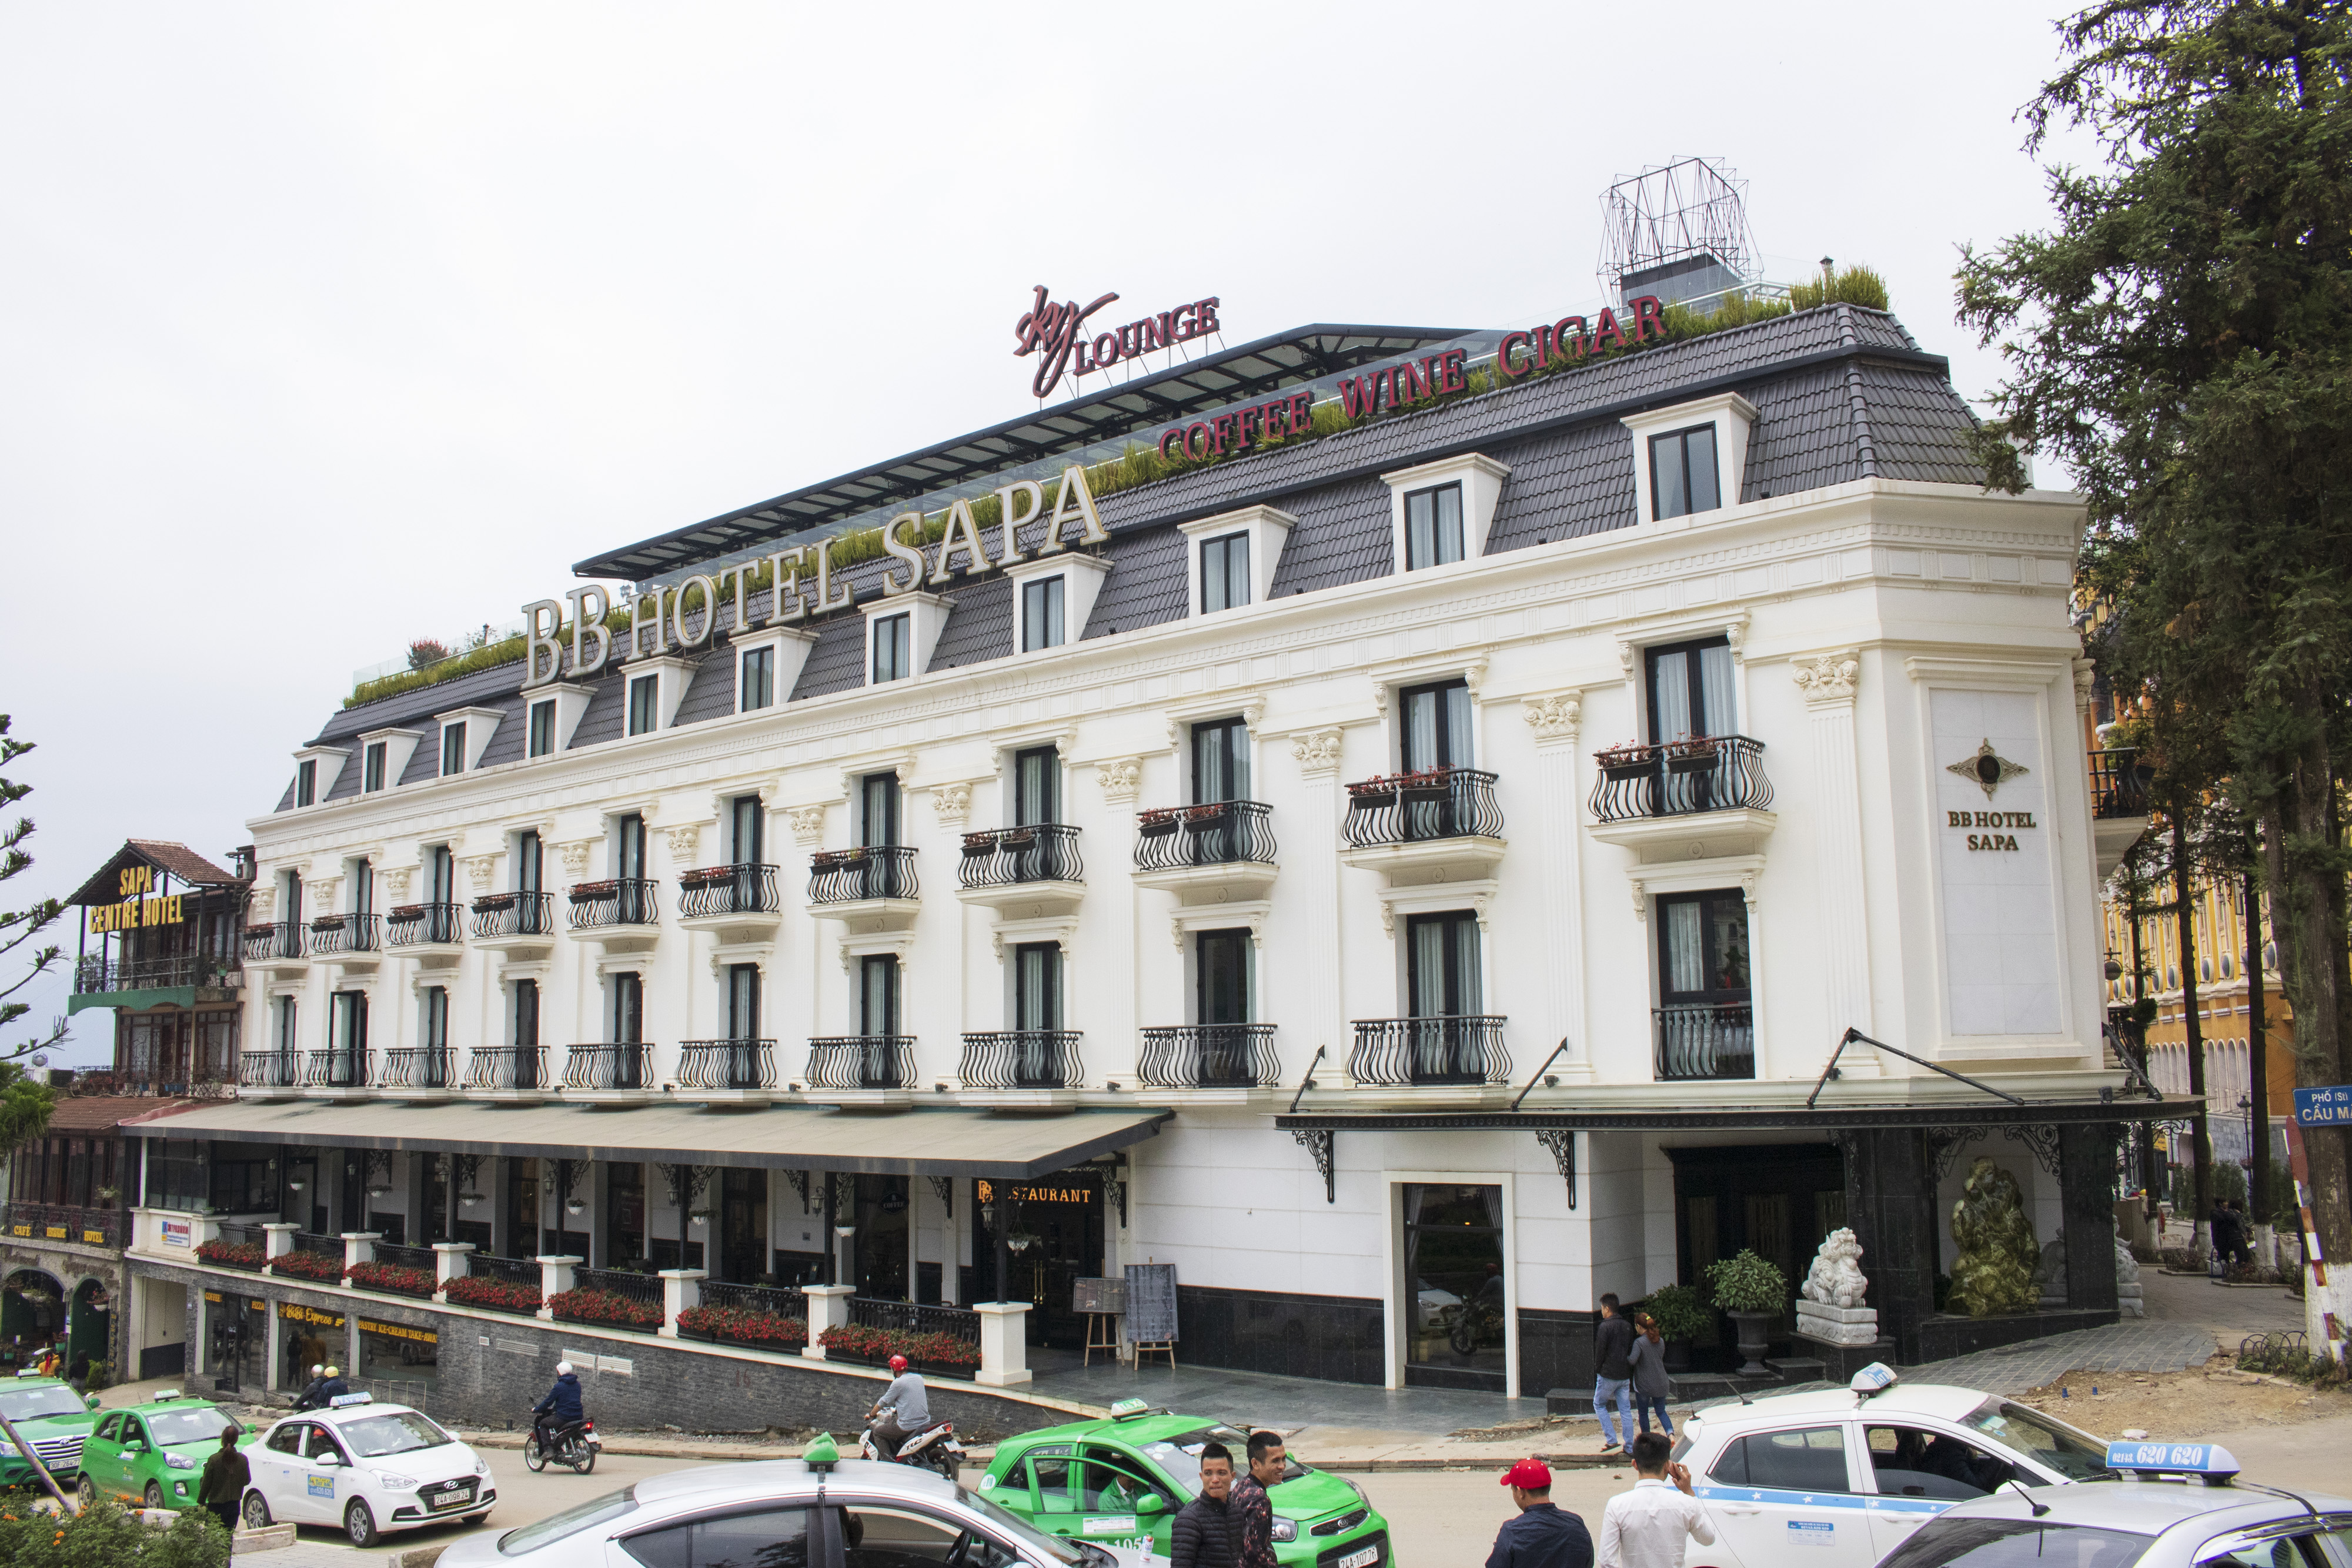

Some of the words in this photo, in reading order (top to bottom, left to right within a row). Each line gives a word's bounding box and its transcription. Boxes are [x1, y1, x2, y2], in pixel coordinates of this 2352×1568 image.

[1073, 296, 1220, 376] LOUNGE
[1158, 390, 1315, 466] COFFEE
[1337, 347, 1469, 419] WINE
[1498, 295, 1669, 378] CIGAR
[520, 584, 612, 690] BB
[626, 536, 854, 663] HOTEL
[882, 464, 1112, 597] SAPA
[1947, 811, 1972, 827] BB
[1973, 811, 2036, 828] HOTEL
[1966, 834, 2019, 851] SAPA
[119, 865, 152, 896] SAPA
[89, 900, 139, 934] CENTRE
[142, 895, 184, 927] HOTEL
[2311, 1089, 2331, 1103] PHỐ
[2334, 1092, 2348, 1102] (St)
[2302, 1103, 2333, 1121] CẦU
[14, 1223, 32, 1236] CAFÉ
[83, 1231, 104, 1243] HOTEL
[205, 1292, 222, 1303] COFFEE
[251, 1300, 265, 1310] PIZZA
[305, 1308, 333, 1326] Express
[358, 1320, 377, 1332] PASTRY
[378, 1325, 407, 1338] ICE-CREAM
[1118, 1399, 1145, 1410] TAXI
[2136, 1445, 2167, 1465] 620
[2170, 1446, 2203, 1466] 620
